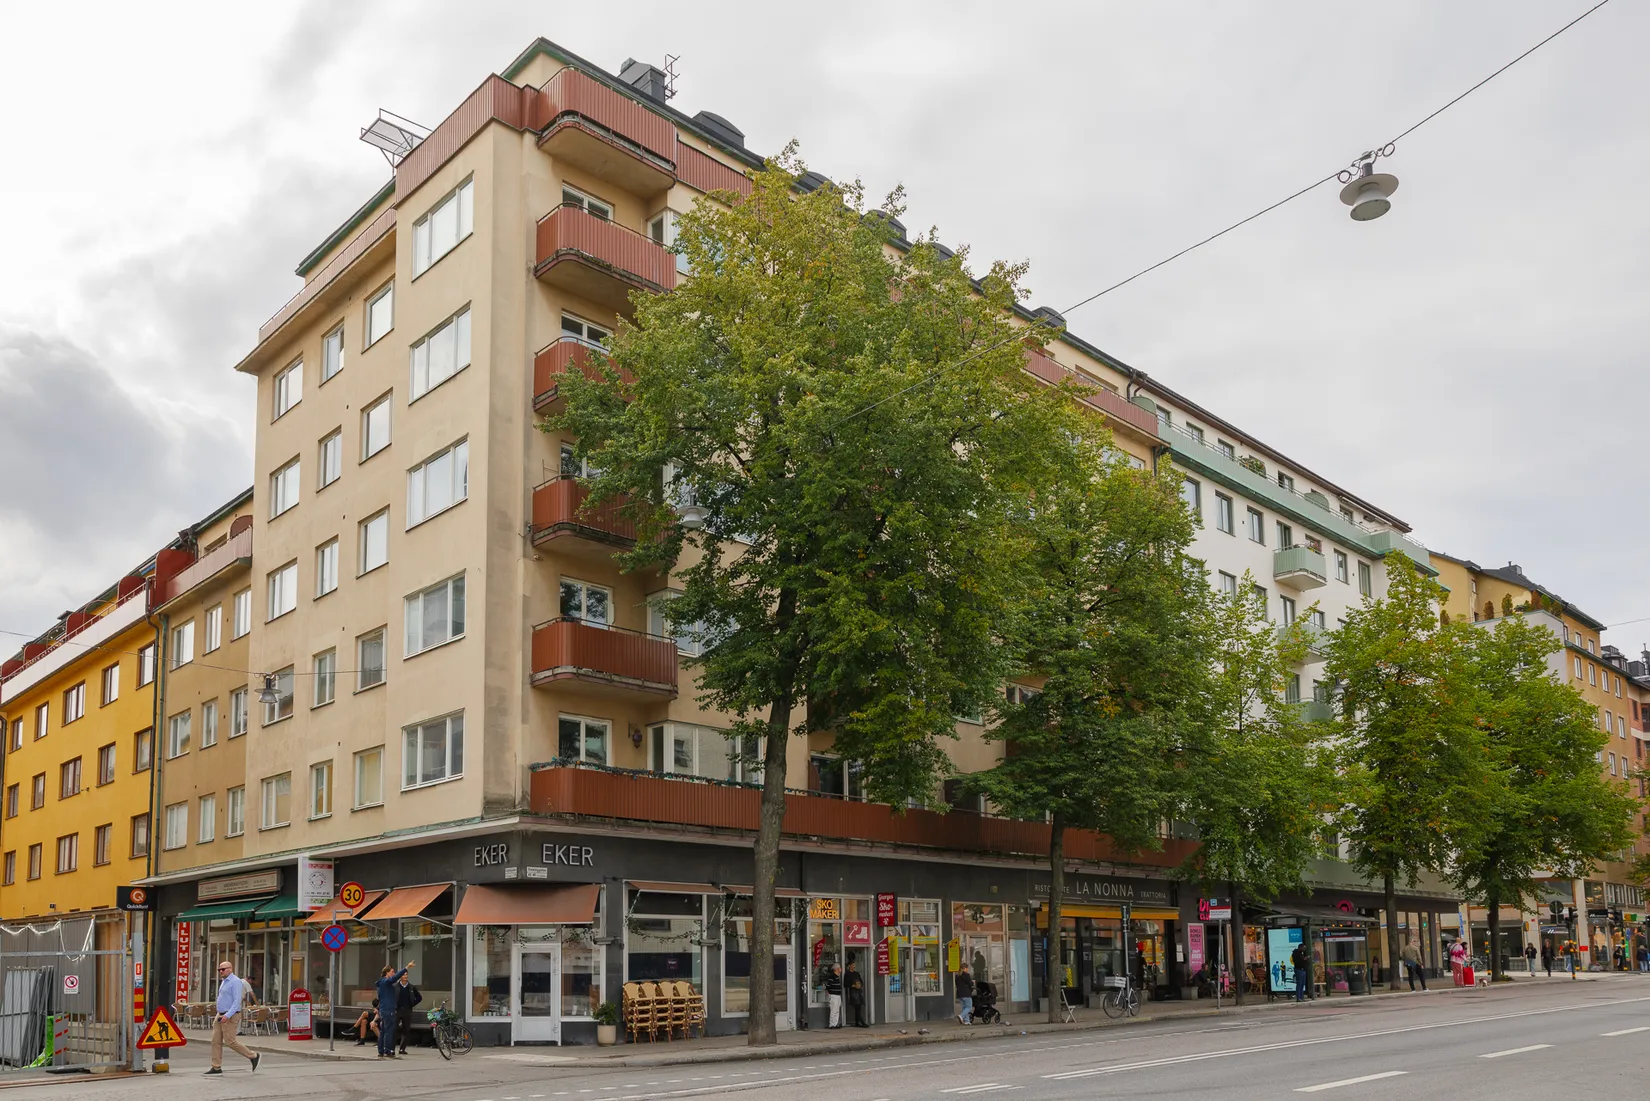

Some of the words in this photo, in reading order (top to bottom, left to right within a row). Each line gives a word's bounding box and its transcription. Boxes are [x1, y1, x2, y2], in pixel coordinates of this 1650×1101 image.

[474, 844, 507, 866] EKER
[542, 843, 594, 867] EKER
[344, 888, 362, 902] 30
[1034, 884, 1070, 894] RISTOTE
[1076, 881, 1090, 895] LA
[1094, 882, 1134, 897] NONNA
[1140, 891, 1166, 899] TRATTORIA
[816, 899, 833, 910] SKO
[809, 909, 840, 919] MAKERI
[176, 922, 190, 1006] ILUTHYRNING
